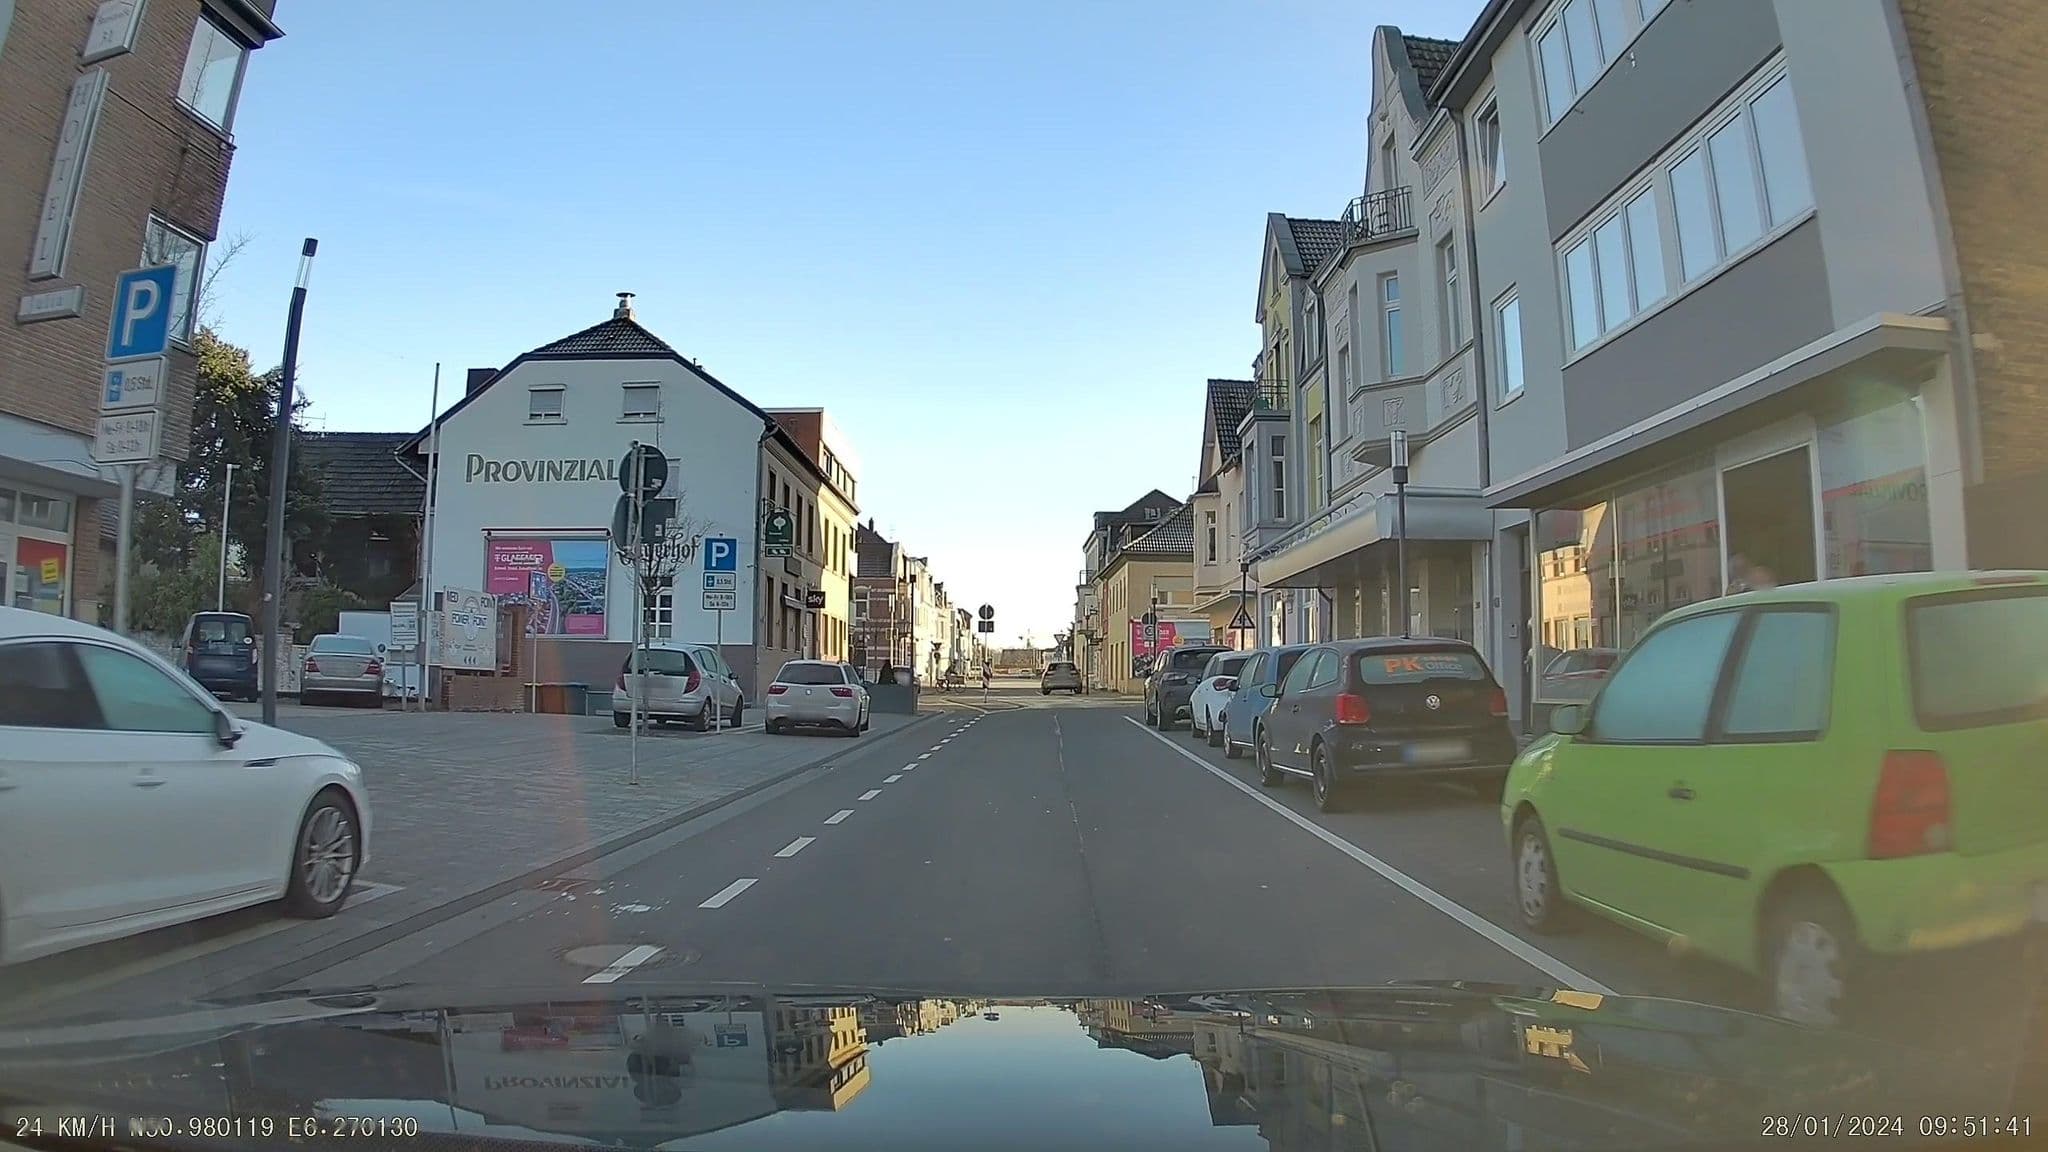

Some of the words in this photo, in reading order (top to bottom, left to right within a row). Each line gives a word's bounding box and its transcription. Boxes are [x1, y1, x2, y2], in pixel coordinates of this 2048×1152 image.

[121, 279, 160, 347] P
[465, 453, 619, 483] PROVINZIAL
[711, 542, 730, 567] P
[807, 594, 824, 605] sky
[1384, 656, 1424, 673] PK
